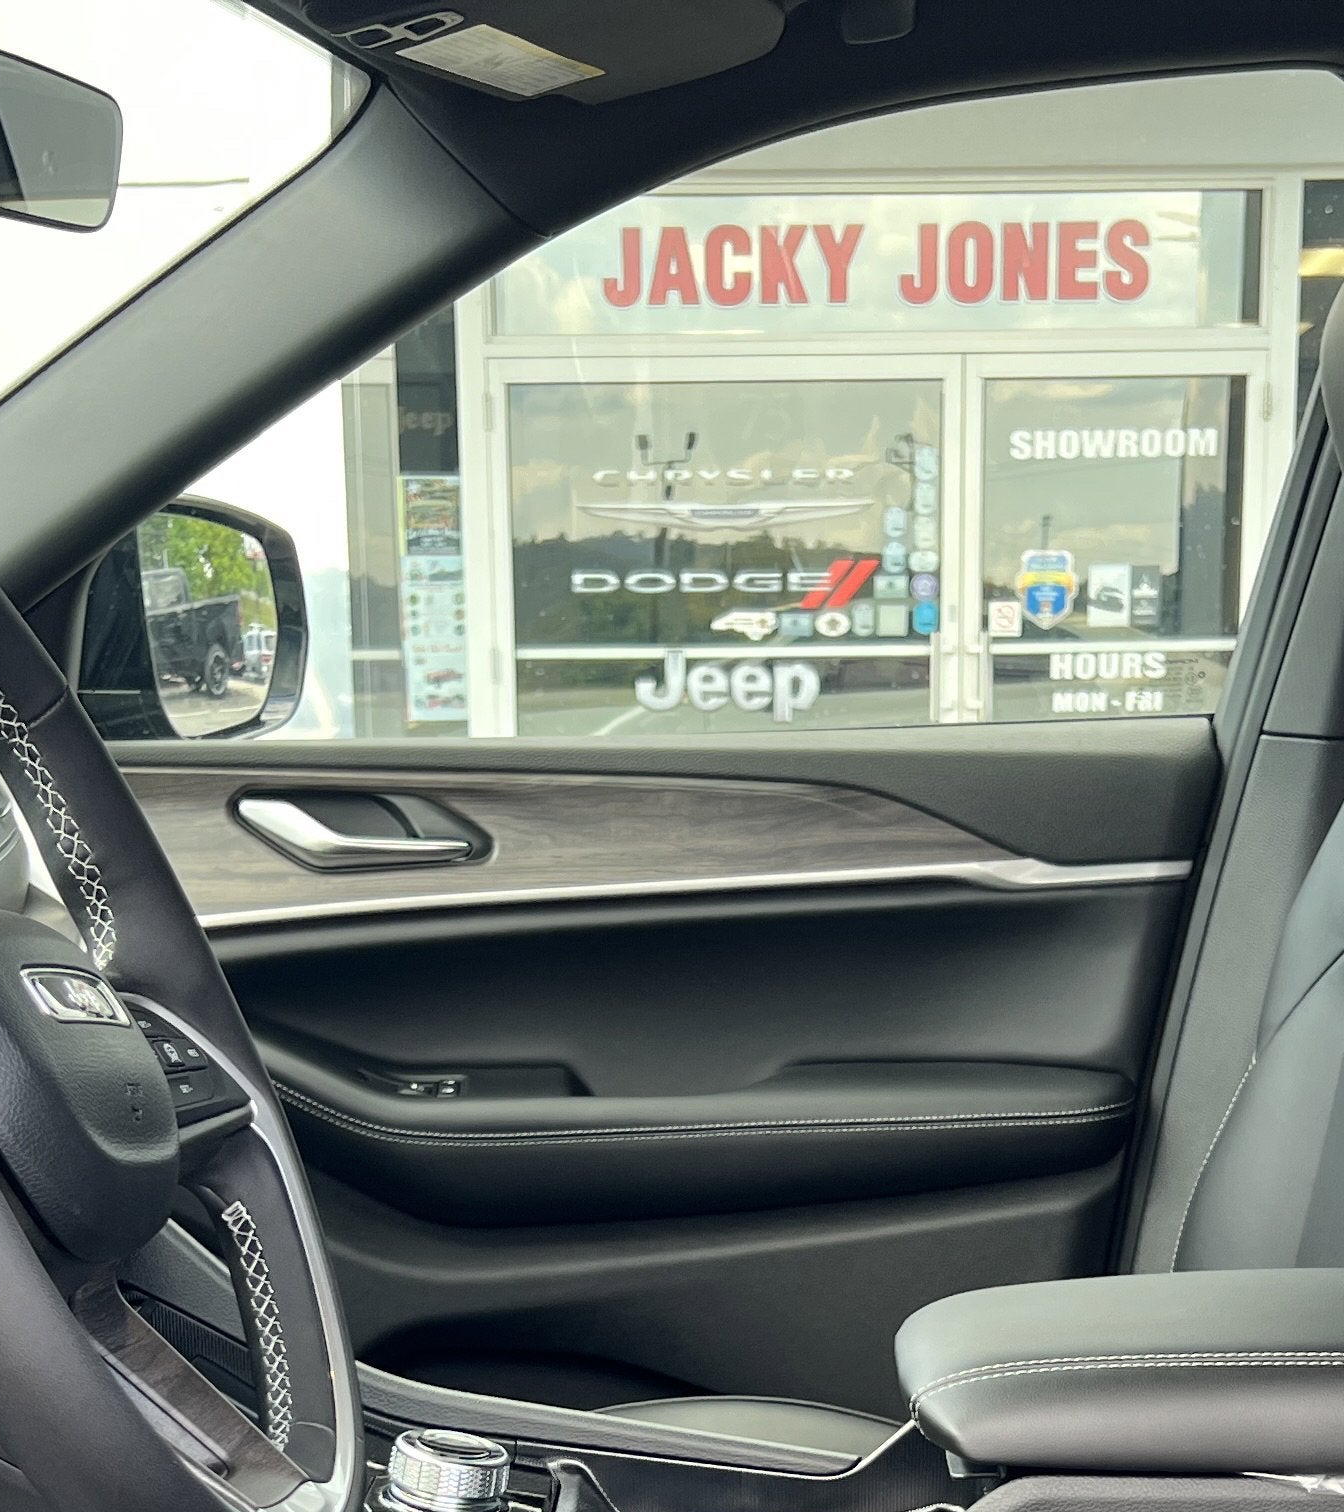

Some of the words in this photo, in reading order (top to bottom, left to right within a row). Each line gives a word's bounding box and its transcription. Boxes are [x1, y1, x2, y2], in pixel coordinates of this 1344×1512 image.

[602, 223, 864, 308] JACKY
[899, 220, 1151, 306] JONES
[1009, 429, 1218, 459] SHOWROOM
[592, 467, 855, 487] CHRYSLER
[570, 569, 833, 594] DODGE
[1048, 651, 1168, 681] HOURS
[634, 650, 821, 722] Jeep
[1052, 691, 1108, 713] MON
[1125, 690, 1164, 712] FRI
